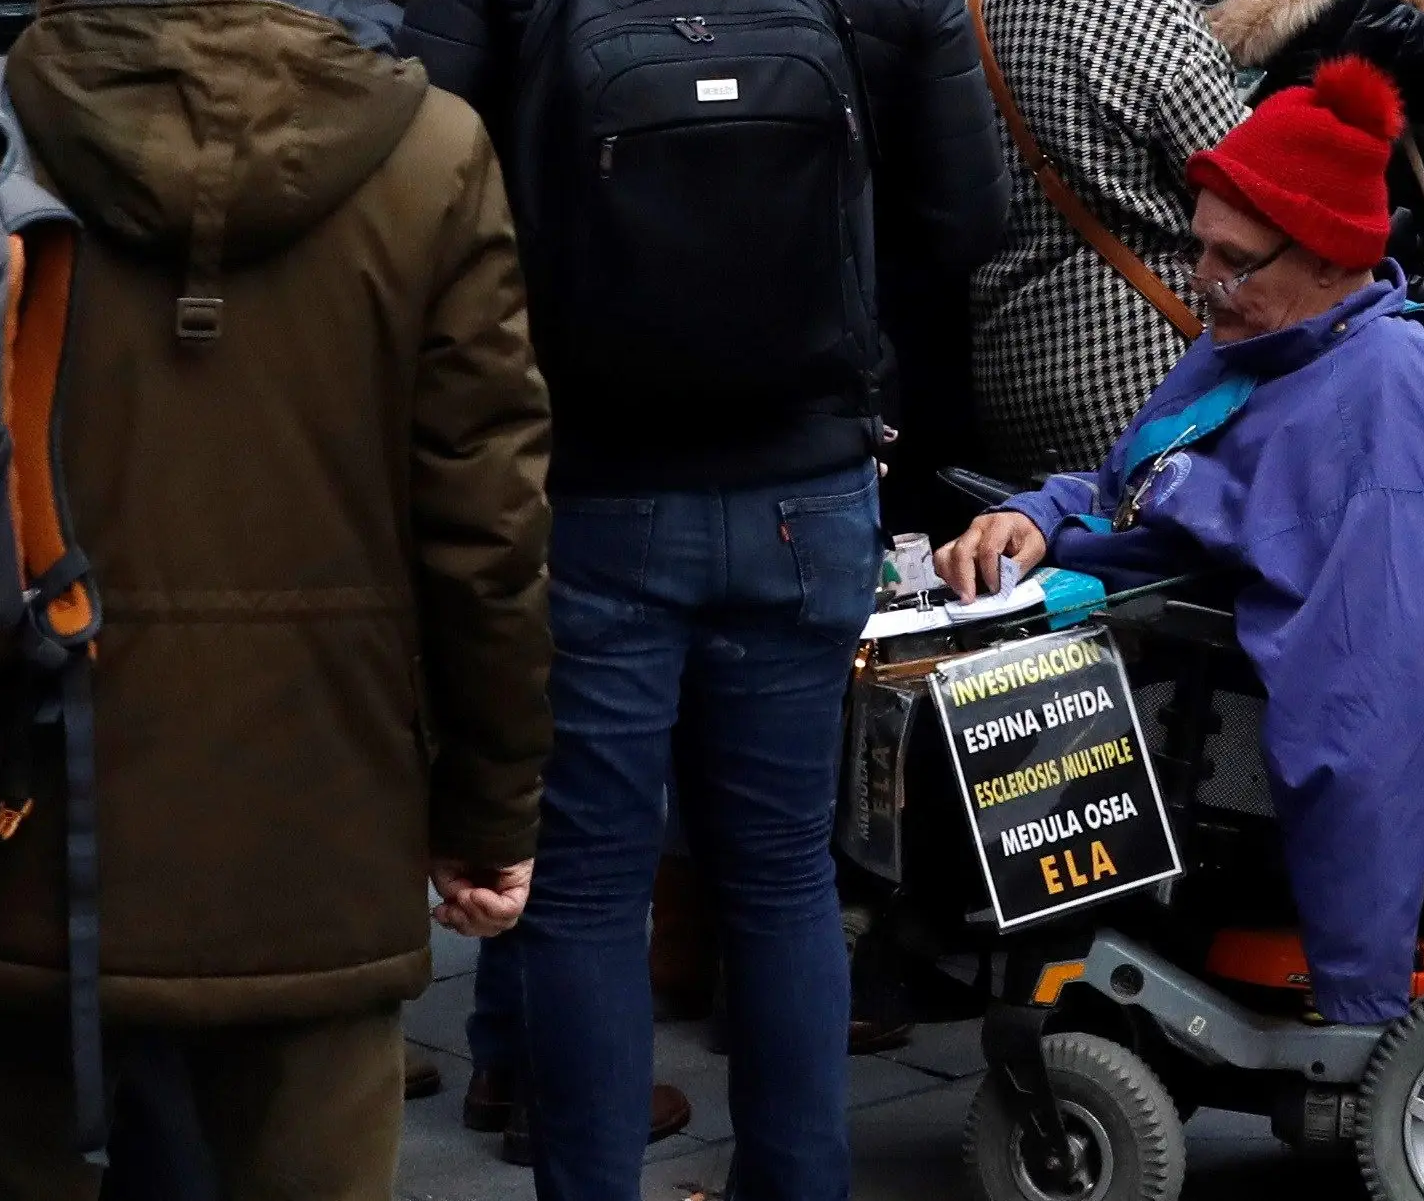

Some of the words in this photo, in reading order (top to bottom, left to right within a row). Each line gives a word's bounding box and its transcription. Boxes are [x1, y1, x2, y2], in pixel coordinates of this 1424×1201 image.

[949, 638, 1102, 709] INVESTIGACIÓN
[963, 707, 1041, 755] ESPINA
[1044, 685, 1115, 730] BÍFIDA
[974, 758, 1061, 810] ESCLEROSIS
[1065, 736, 1134, 782] MULTIPLE
[1000, 808, 1082, 857] MEDULA
[1084, 793, 1138, 830] OSEA
